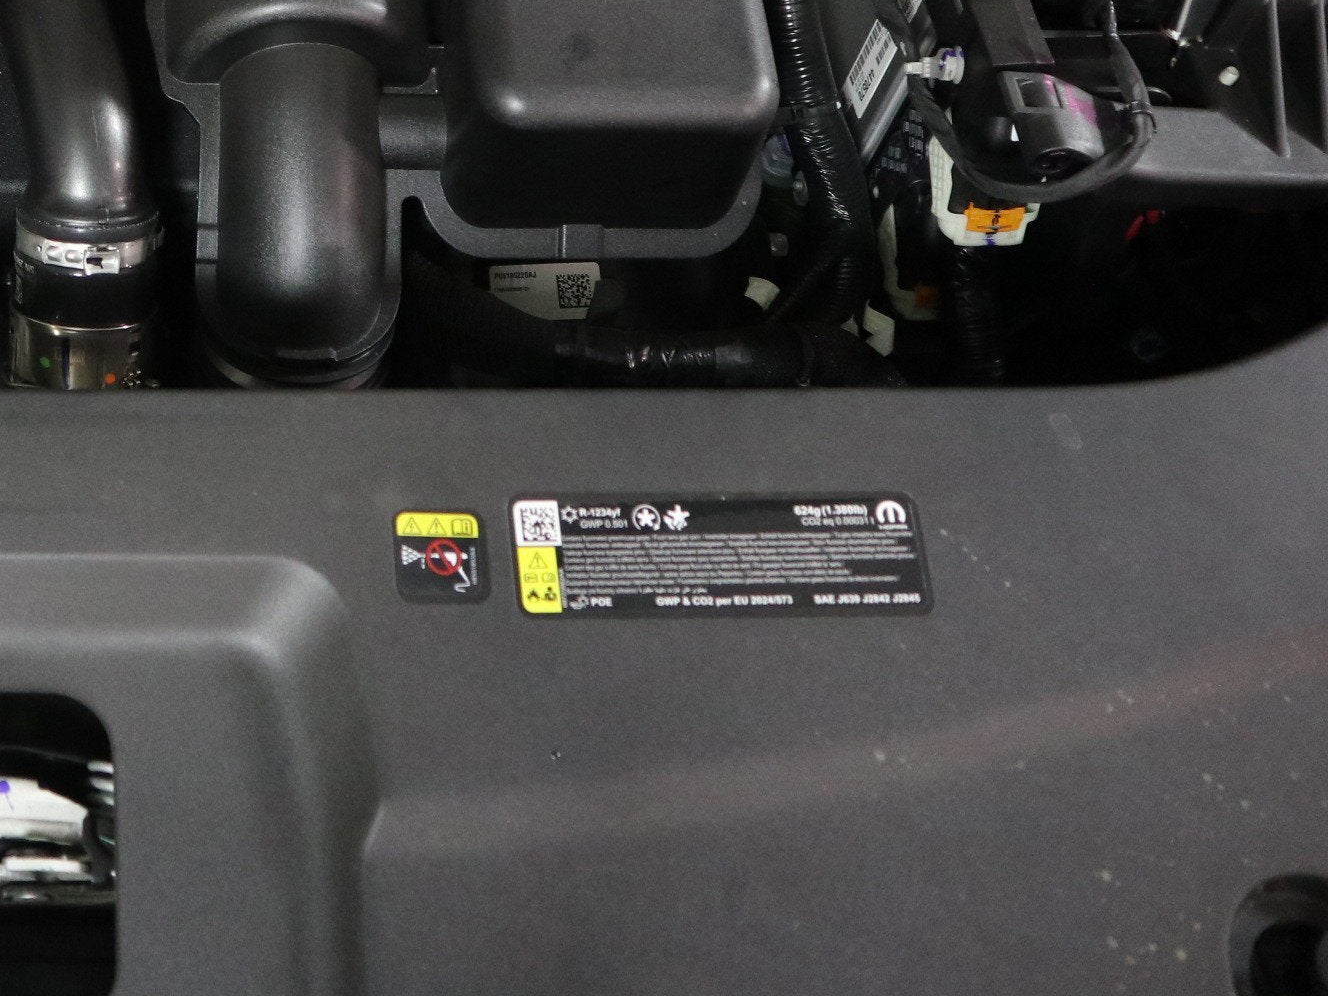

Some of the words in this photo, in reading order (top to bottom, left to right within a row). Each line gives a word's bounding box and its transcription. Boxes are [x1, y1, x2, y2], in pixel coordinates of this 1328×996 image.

[578, 506, 621, 518] R-1234yf
[580, 519, 604, 529] GWP
[655, 596, 681, 607] GWP
[692, 596, 714, 606] CO2
[715, 597, 732, 608] per
